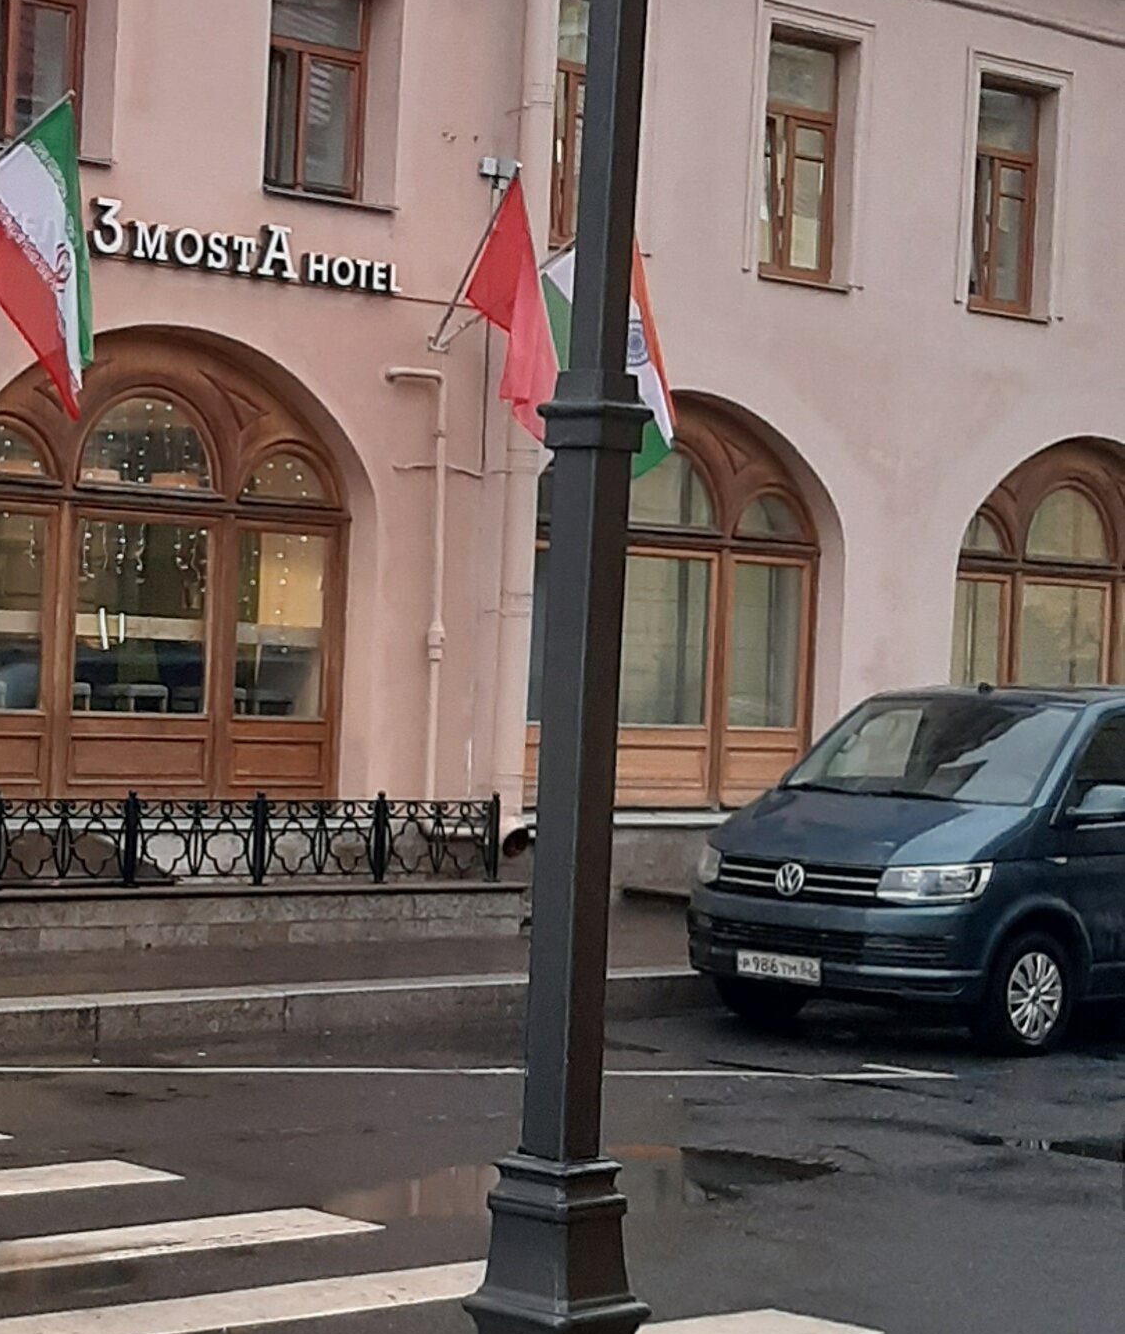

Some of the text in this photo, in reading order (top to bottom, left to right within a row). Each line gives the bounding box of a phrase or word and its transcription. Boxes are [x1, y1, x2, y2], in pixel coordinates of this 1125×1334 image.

[93, 197, 403, 293] 3 MOSTA HOTEL
